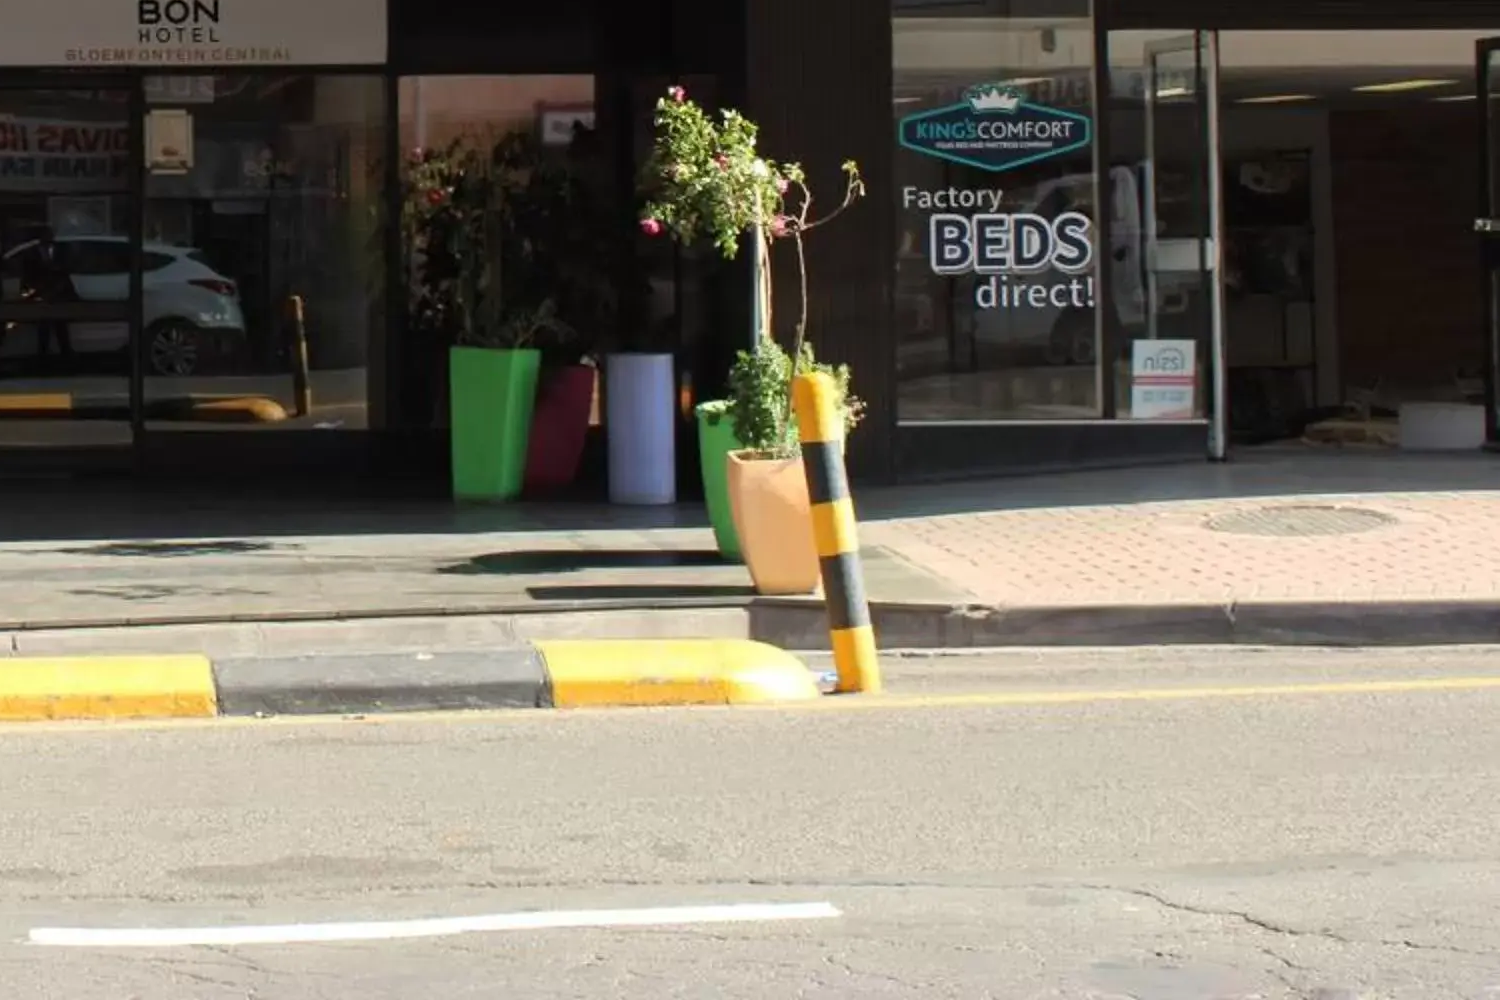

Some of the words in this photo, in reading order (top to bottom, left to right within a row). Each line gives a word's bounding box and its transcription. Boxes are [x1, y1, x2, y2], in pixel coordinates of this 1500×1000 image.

[138, 27, 220, 43] HOTEL
[64, 48, 206, 62] BLOEMFONTEIN
[211, 47, 292, 61] CENTRAL
[903, 186, 1003, 212] Factory
[930, 211, 1093, 275] BEDS
[975, 276, 1096, 308] direct!
